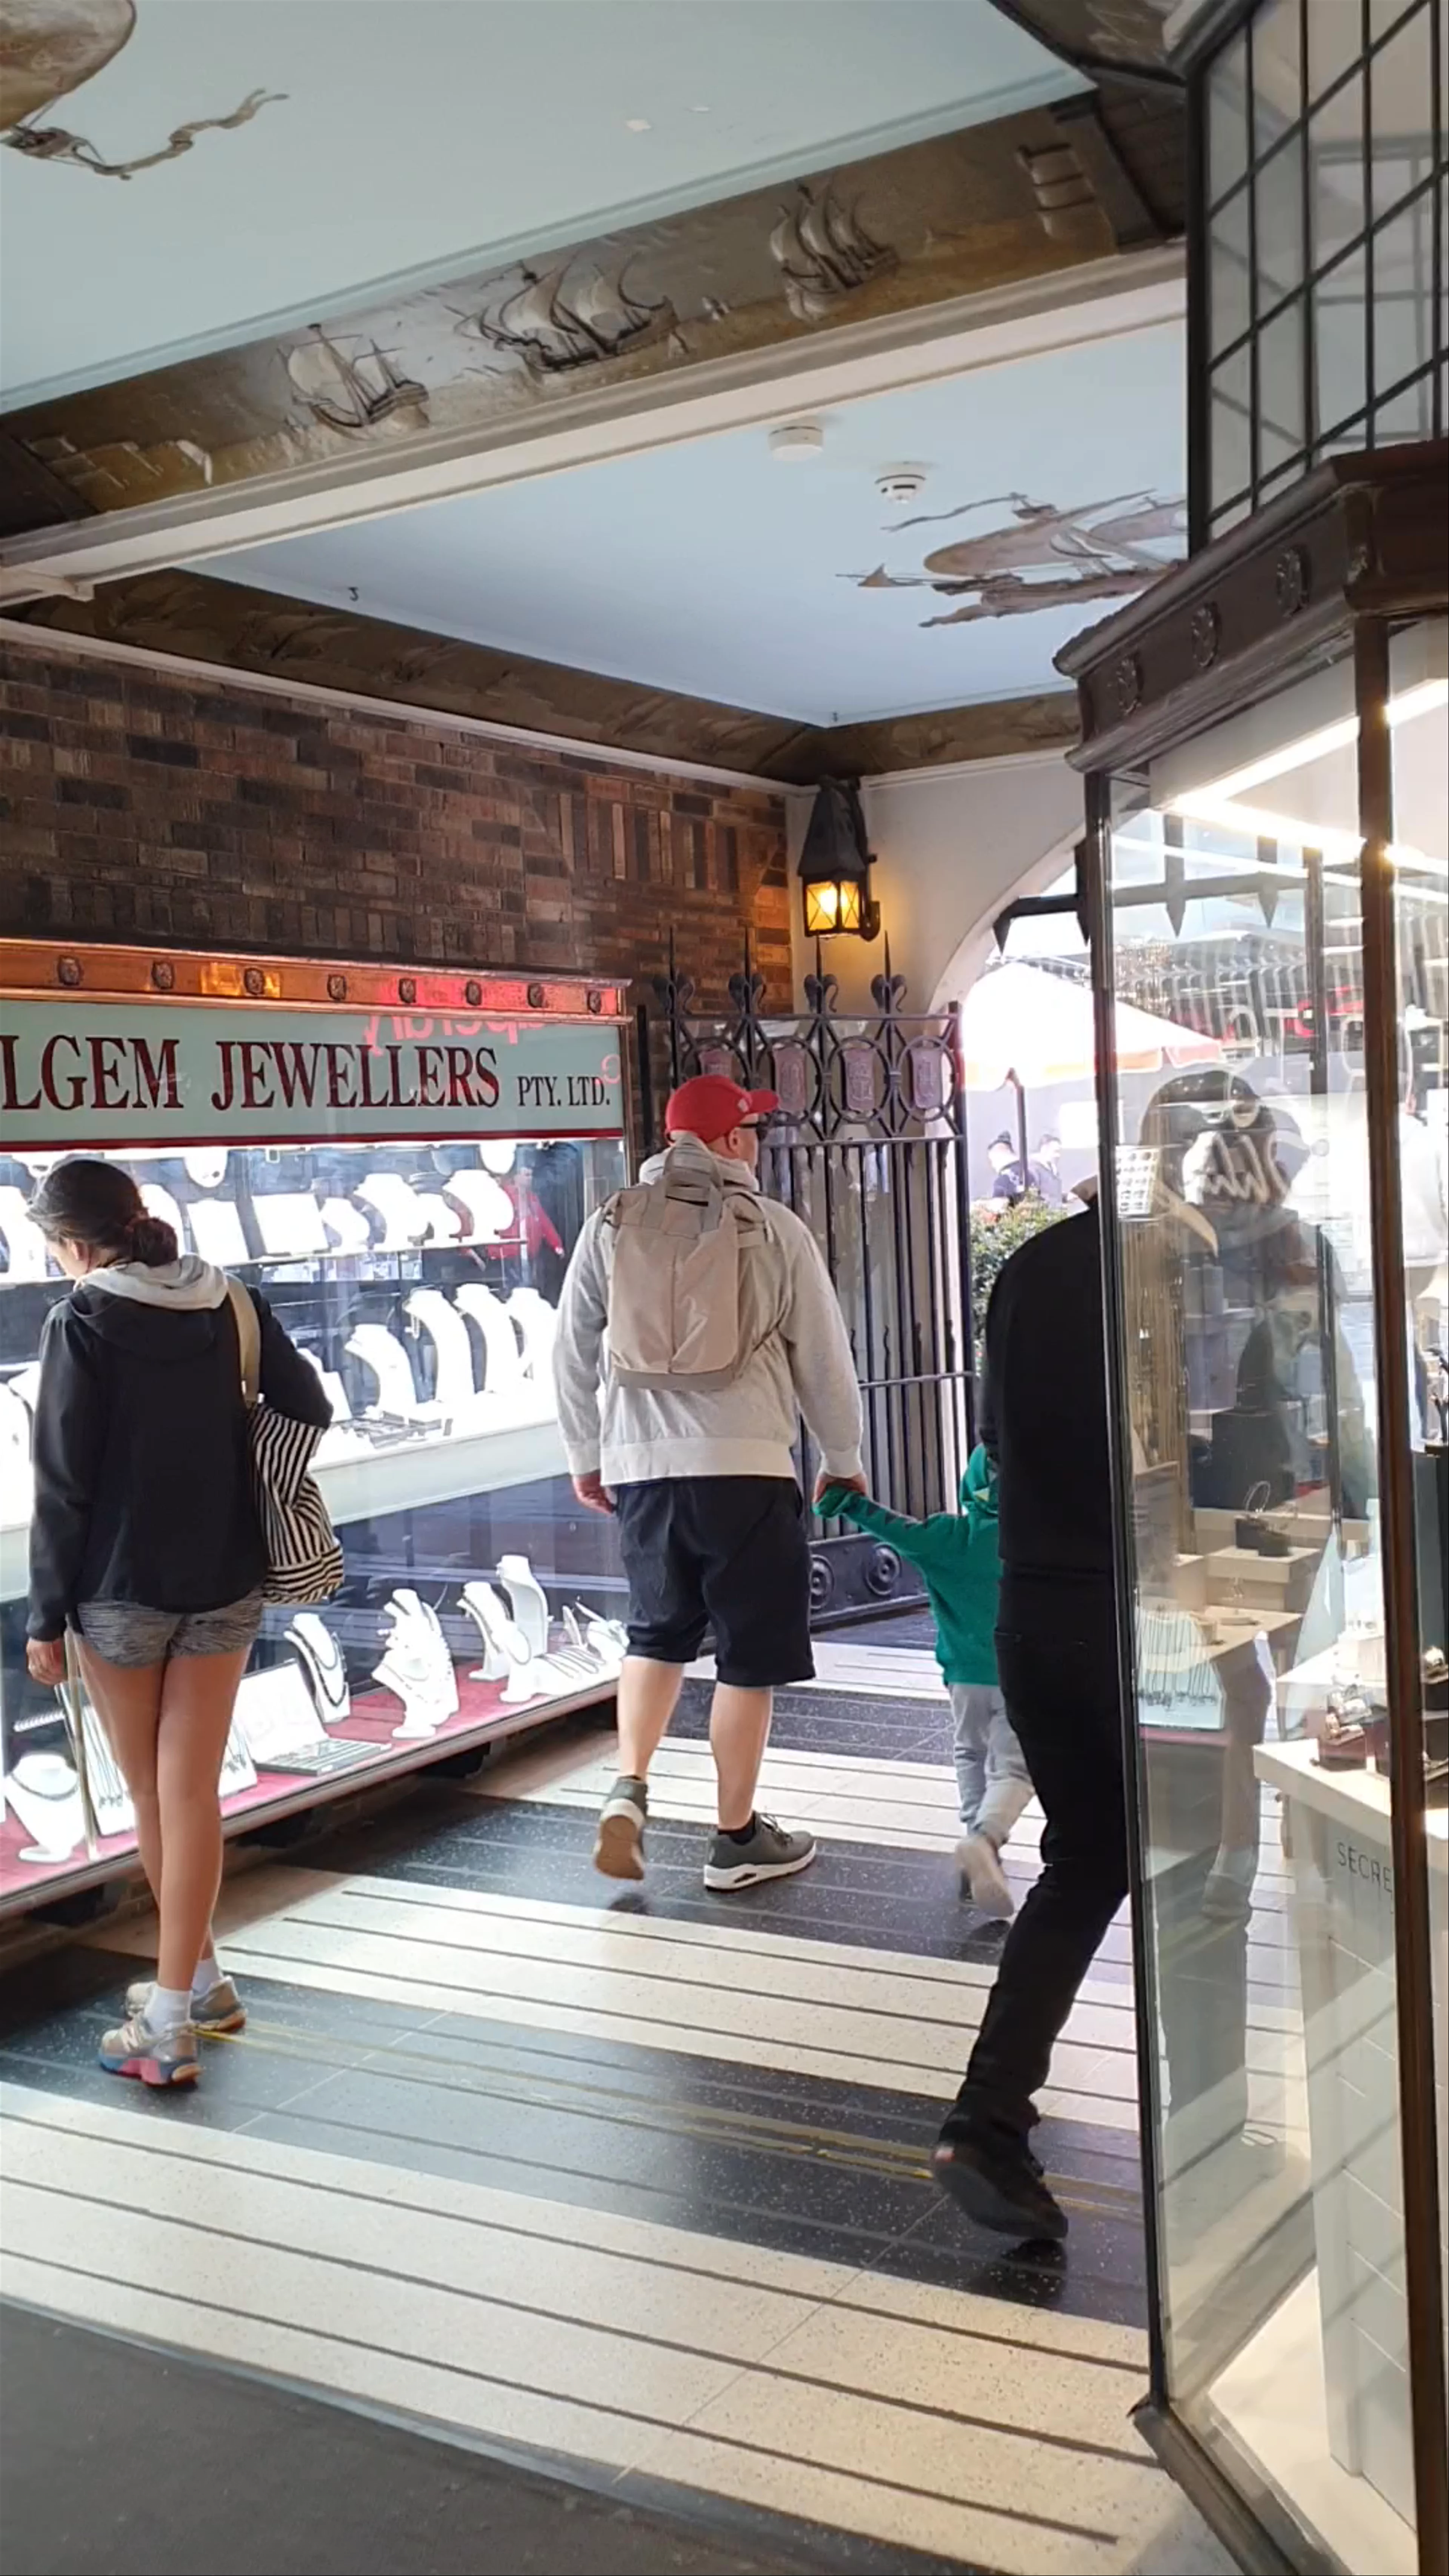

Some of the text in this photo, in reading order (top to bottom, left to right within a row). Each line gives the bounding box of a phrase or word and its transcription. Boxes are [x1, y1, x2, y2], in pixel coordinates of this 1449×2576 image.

[0, 1035, 610, 1110] LGEM JEWELLERS PTY. LTD.
